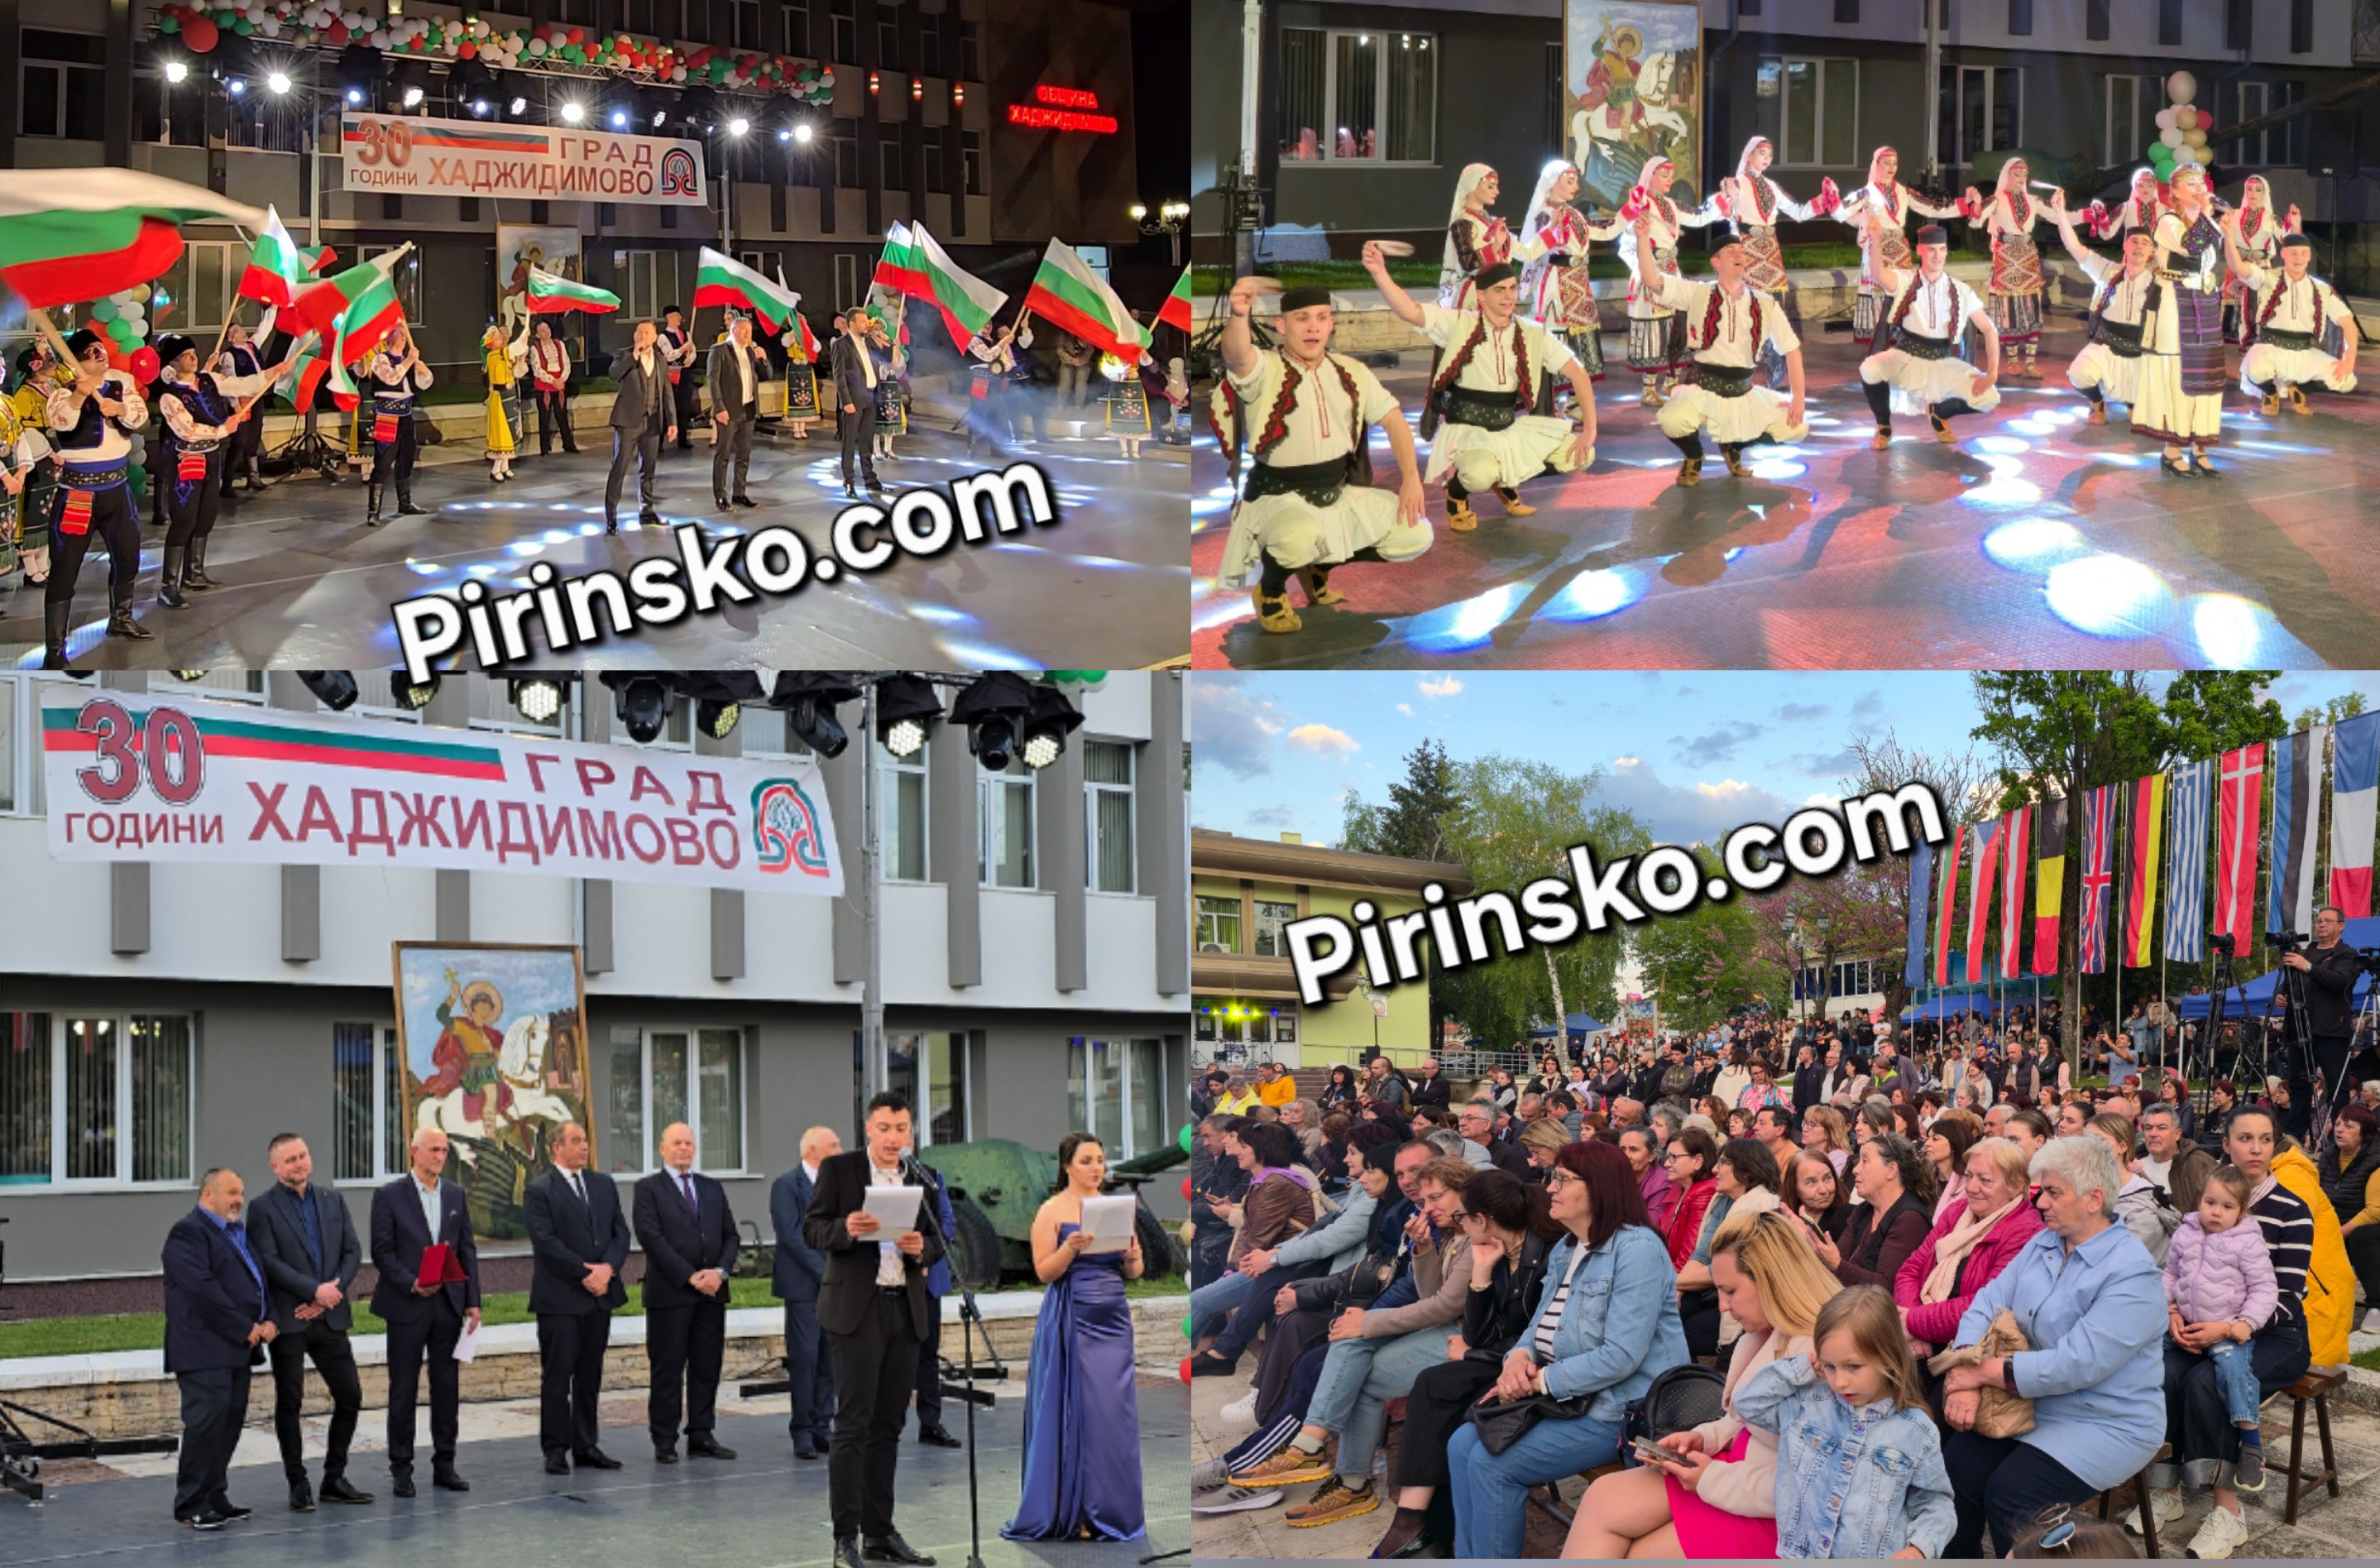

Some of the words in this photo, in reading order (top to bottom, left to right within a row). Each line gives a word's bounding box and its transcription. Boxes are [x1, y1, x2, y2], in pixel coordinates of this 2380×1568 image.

[1008, 104, 1118, 133] ХАДЖИДМ
[356, 117, 412, 168] 30
[560, 137, 654, 170] ГРАД
[350, 169, 418, 187] ГОДИНИ
[427, 156, 654, 196] ХАДЖИДИМОВО
[75, 698, 205, 806] 30
[524, 752, 736, 817] ГРАД
[65, 811, 224, 850] ГОДИНИ
[246, 781, 741, 870] ХАДЖИДИМОВО
